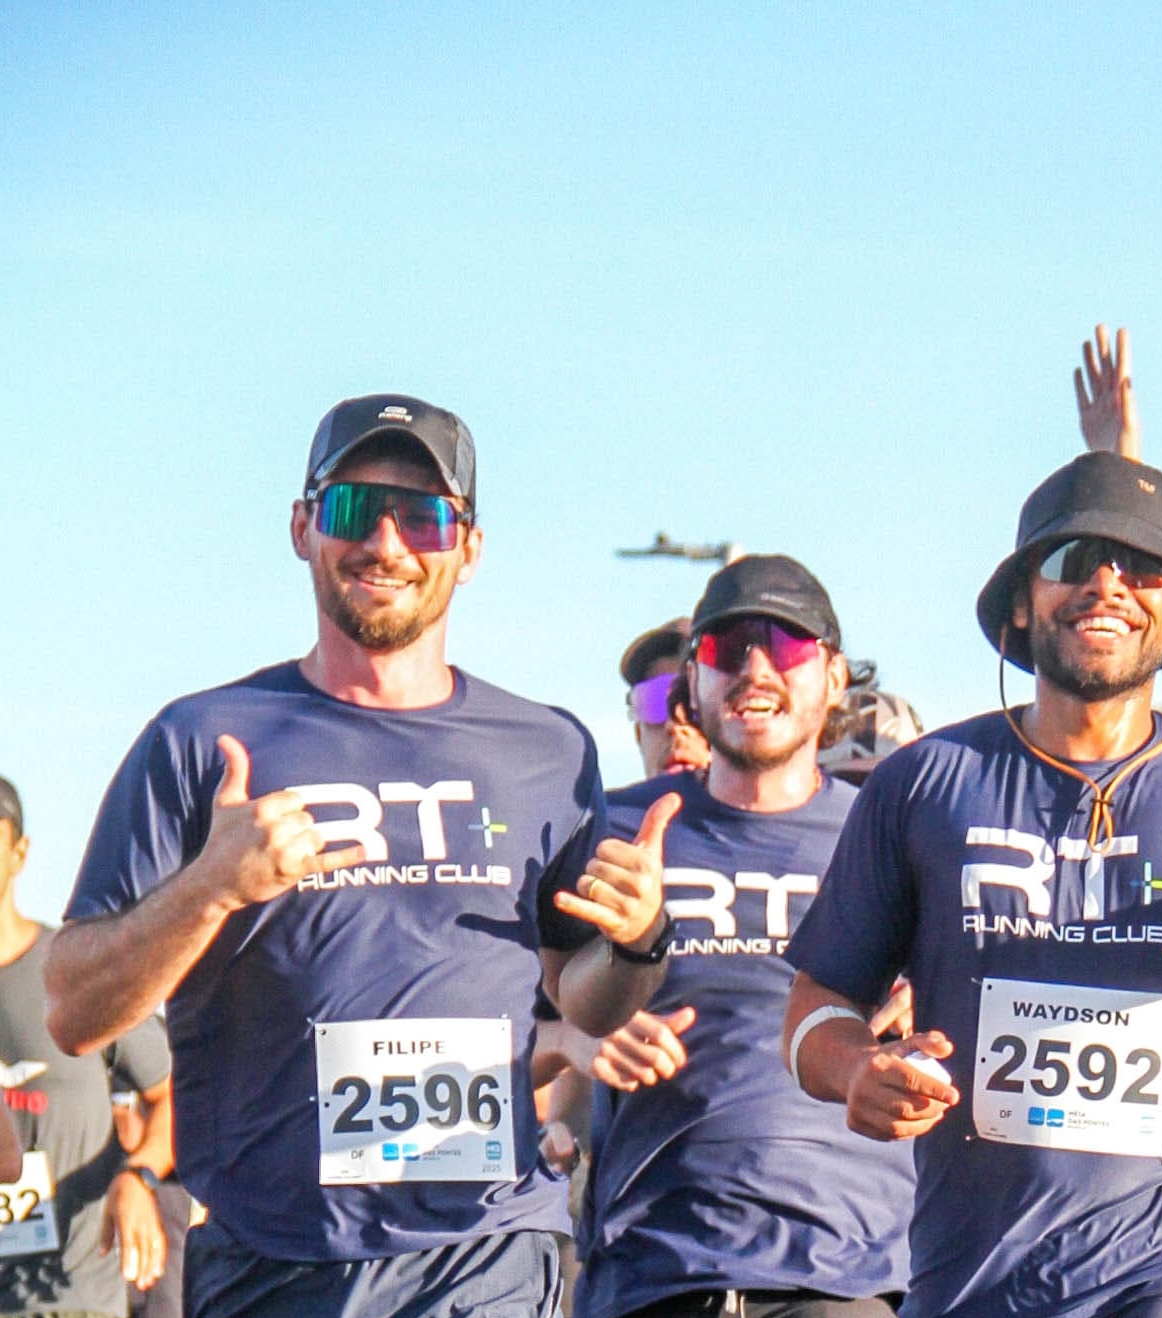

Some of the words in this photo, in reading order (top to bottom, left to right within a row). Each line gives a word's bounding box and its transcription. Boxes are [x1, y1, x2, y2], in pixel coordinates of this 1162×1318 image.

[298, 865, 428, 892] RUNNING
[434, 864, 512, 886] CLUB
[963, 914, 1085, 942] RUNNING
[667, 937, 771, 956] UNNING
[1013, 1000, 1130, 1026] WAYDSON
[373, 1040, 446, 1056] FILIPE
[986, 1034, 1162, 1106] 2592
[331, 1073, 502, 1135] 2596
[1000, 1110, 1013, 1119] DF
